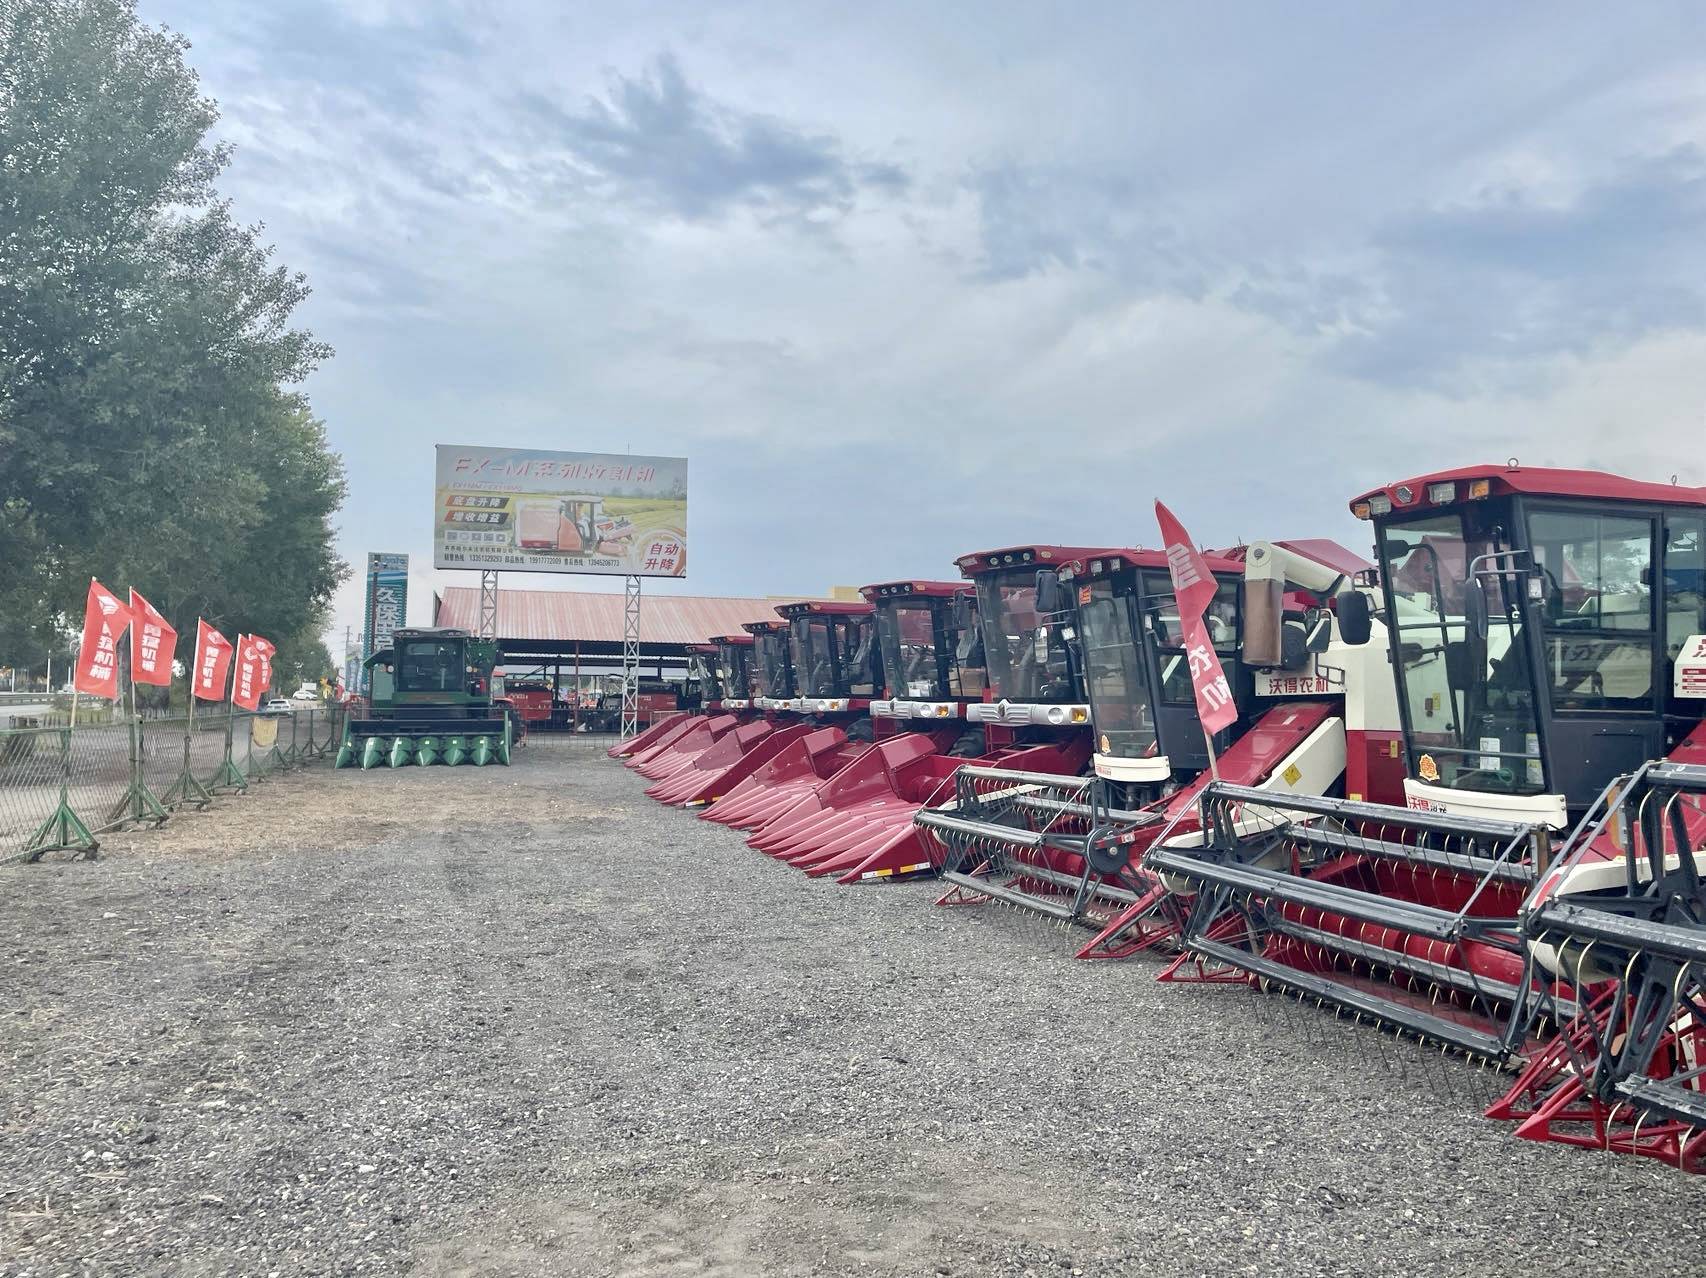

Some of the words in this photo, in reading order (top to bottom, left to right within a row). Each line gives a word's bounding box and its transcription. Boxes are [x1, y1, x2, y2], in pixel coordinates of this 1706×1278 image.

[651, 543, 679, 556] 自动
[645, 559, 674, 571] 升降
[1269, 677, 1329, 694] 沃得农机
